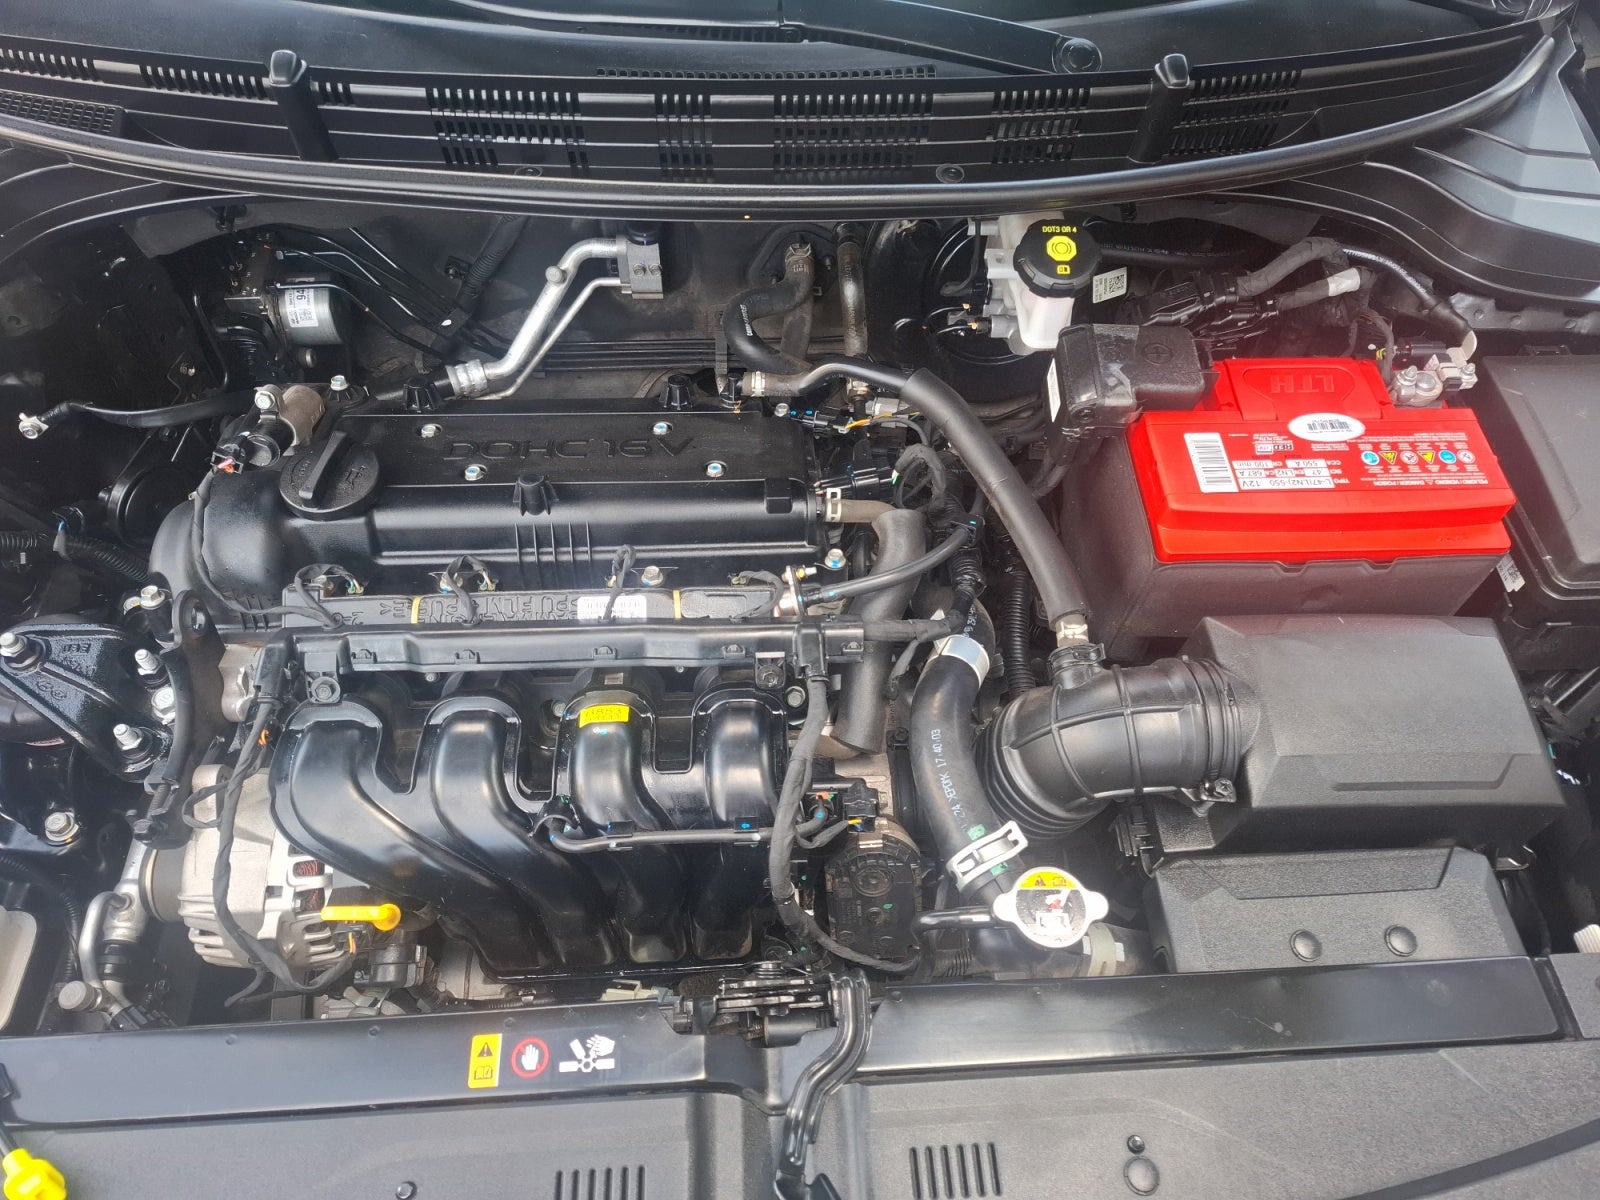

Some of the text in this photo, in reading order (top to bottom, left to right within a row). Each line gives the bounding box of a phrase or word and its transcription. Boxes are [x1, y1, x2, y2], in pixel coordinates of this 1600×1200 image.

[1042, 225, 1077, 234] DOT3 OR 4
[1270, 374, 1335, 393] LTH
[443, 438, 589, 460] DOHC
[1242, 480, 1260, 488] 12V
